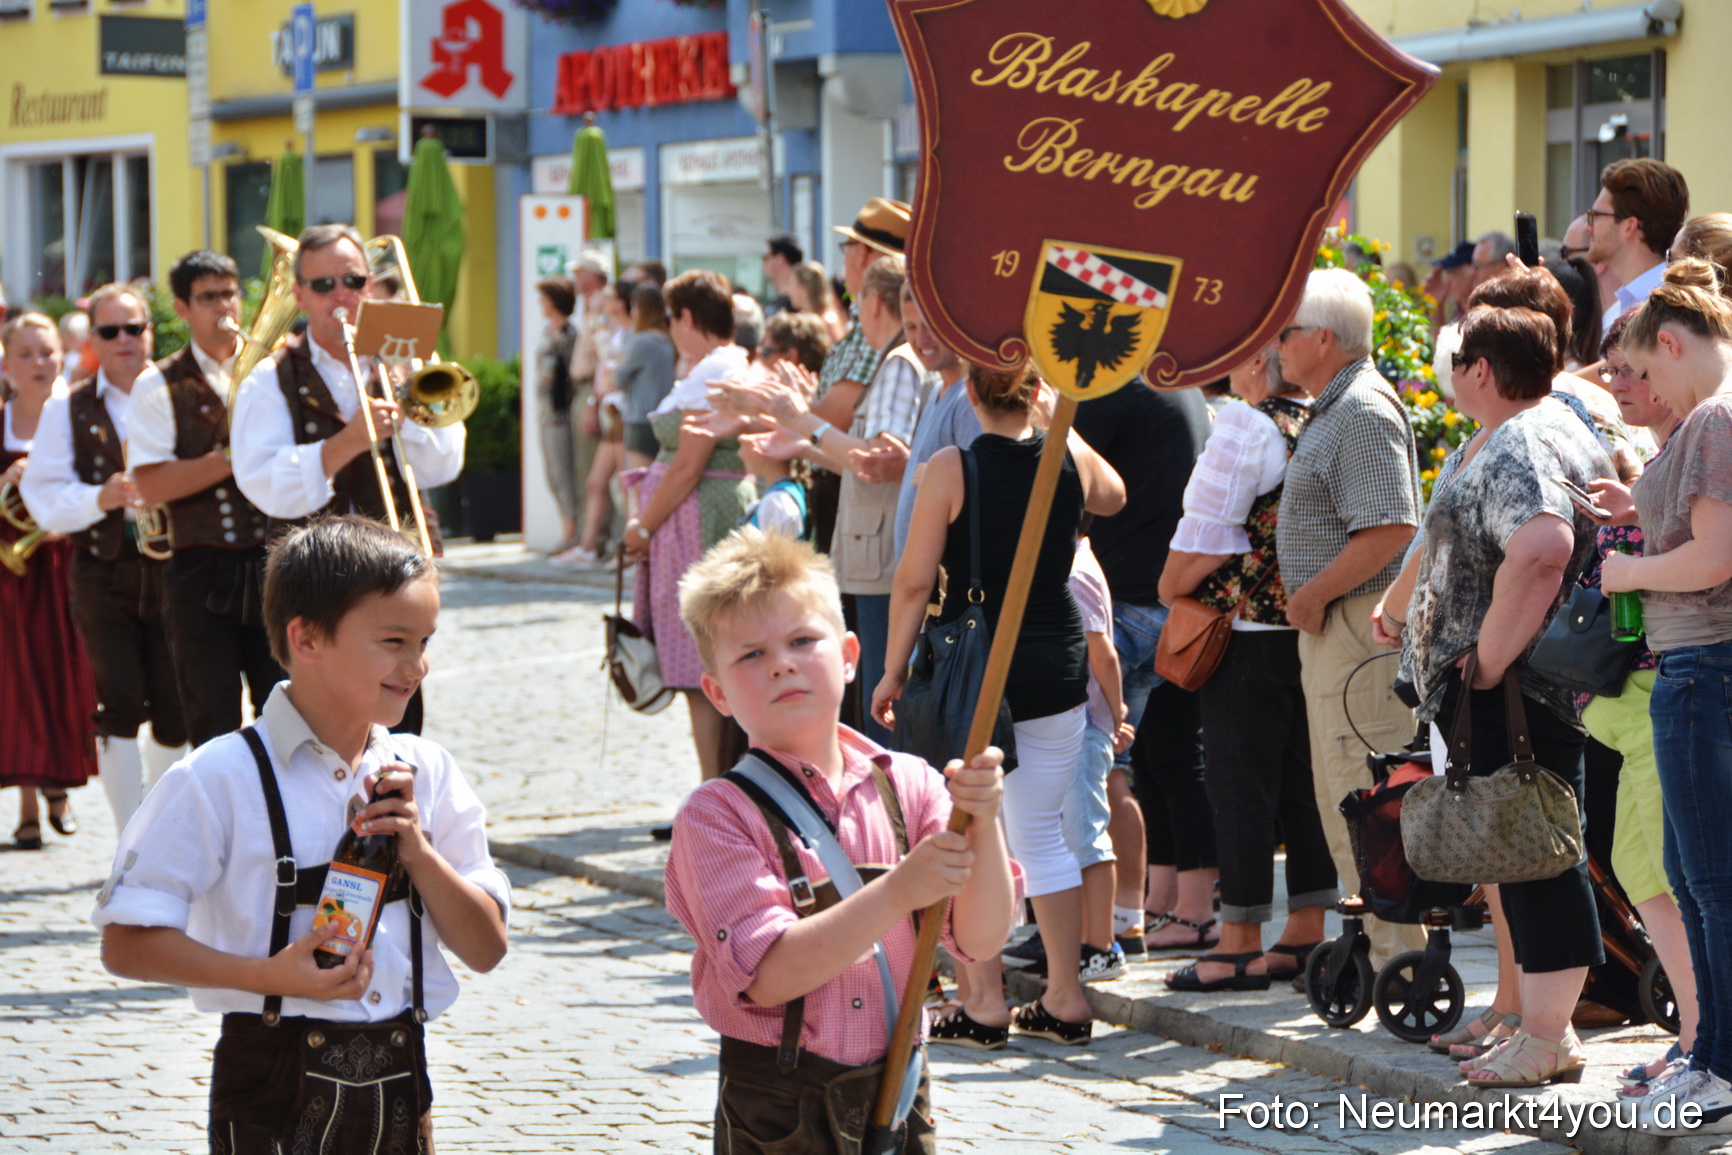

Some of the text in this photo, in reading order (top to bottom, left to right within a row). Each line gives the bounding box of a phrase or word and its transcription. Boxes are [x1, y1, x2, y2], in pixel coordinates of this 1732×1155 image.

[103, 51, 187, 73] TAIFUN
[269, 21, 342, 66] TAUN
[10, 82, 109, 128] Restaurant
[971, 32, 1332, 132] Blaskapelle
[1003, 117, 1260, 209] Berngau
[991, 250, 1224, 305] 19 73
[331, 876, 363, 892] GANSL
